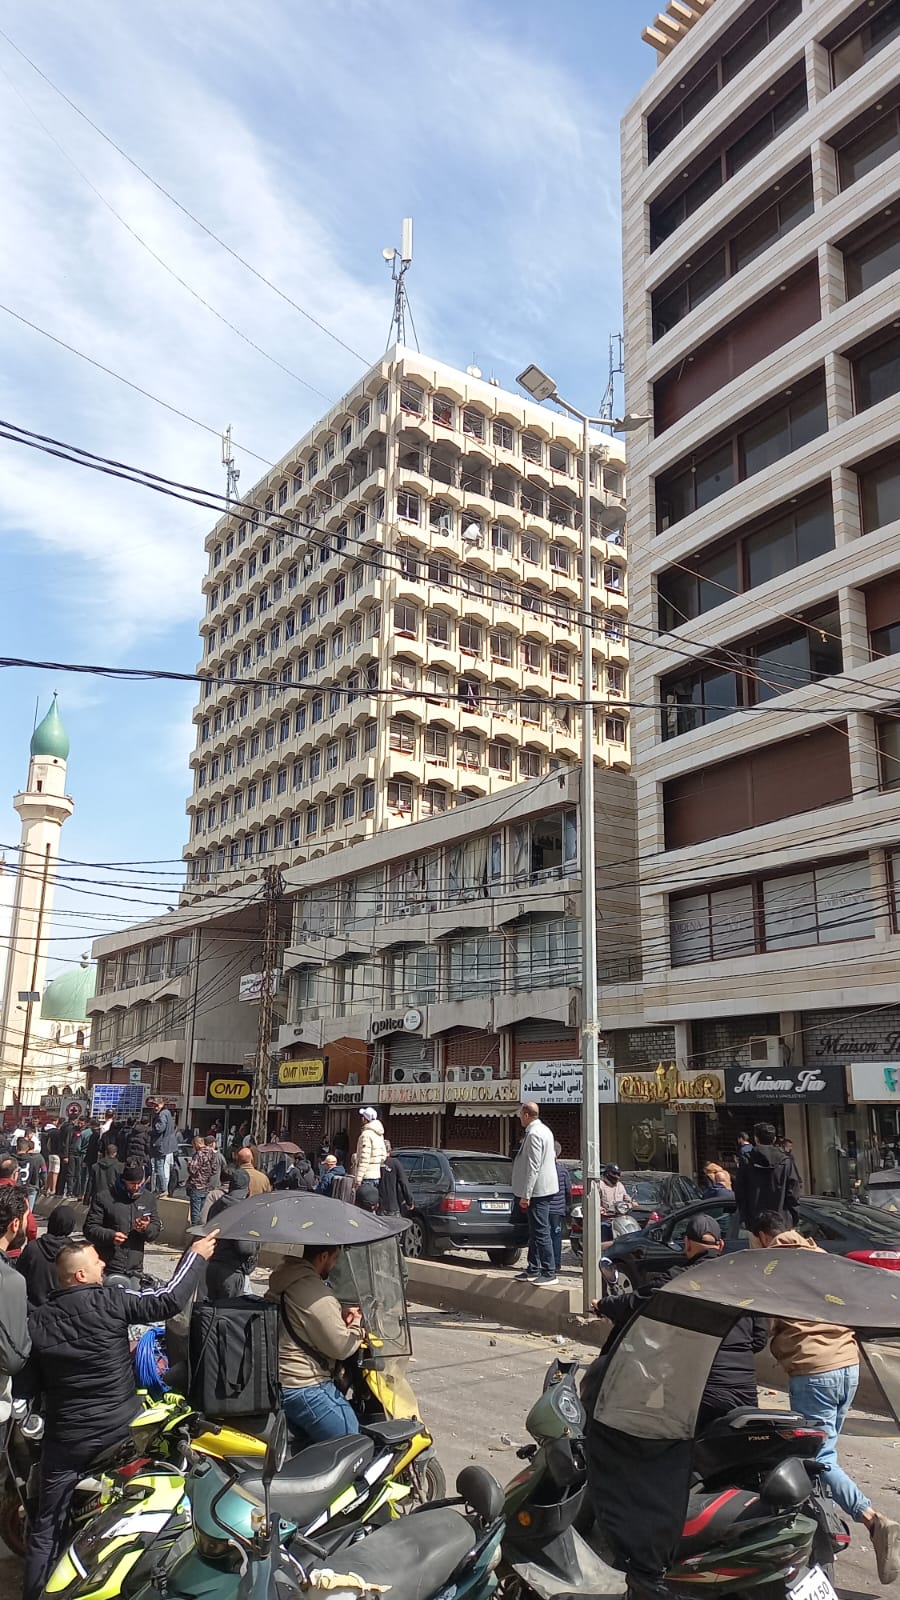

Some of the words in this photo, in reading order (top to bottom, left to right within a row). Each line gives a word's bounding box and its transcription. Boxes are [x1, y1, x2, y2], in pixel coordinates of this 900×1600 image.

[816, 1034, 878, 1055] Maison
[283, 1066, 298, 1079] OMT
[214, 1083, 245, 1095] OMT
[548, 1080, 566, 1094] الحاج
[734, 1070, 794, 1094] Maison
[325, 1085, 365, 1104] General
[446, 1085, 518, 1102] CHOCOLATE
